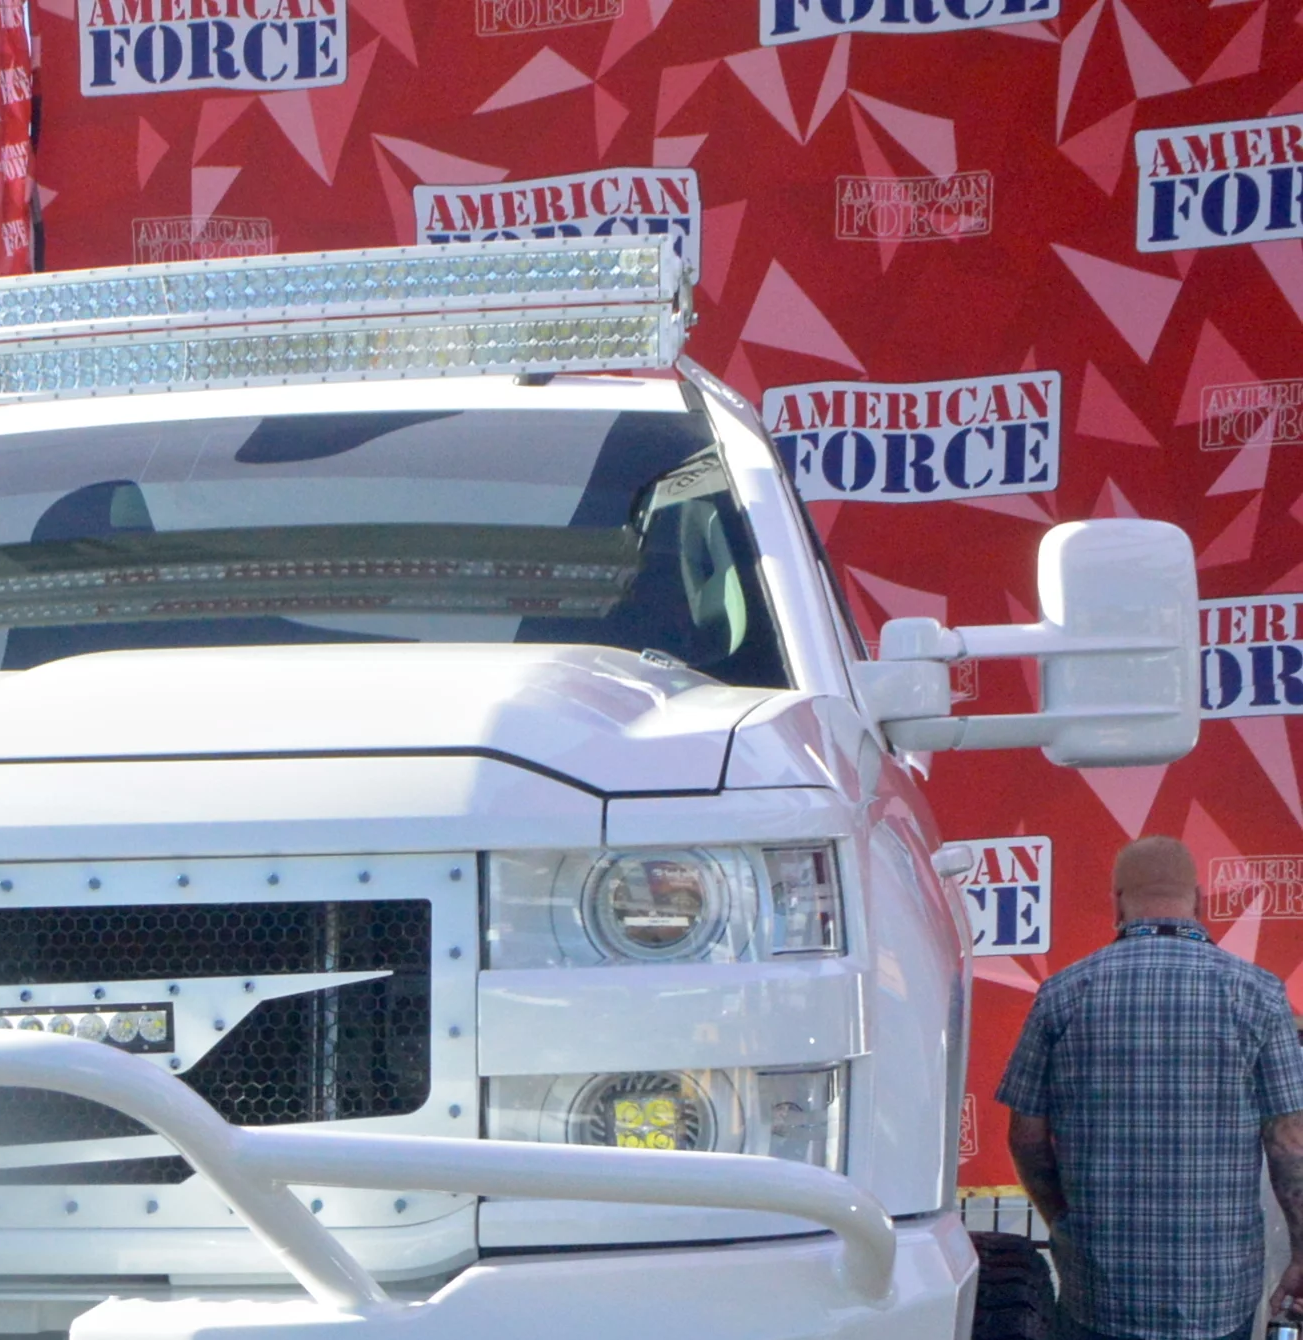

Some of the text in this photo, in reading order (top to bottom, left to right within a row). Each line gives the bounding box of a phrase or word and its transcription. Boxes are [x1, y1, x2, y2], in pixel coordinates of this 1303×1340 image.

[89, 19, 339, 88] FORCE
[424, 177, 690, 231] AMERICAN
[841, 175, 988, 205] AMERICAN
[137, 219, 268, 246] AMERICAN
[841, 200, 988, 237] FORCE
[770, 380, 1053, 433] AMERICAN
[1205, 406, 1303, 446] FOR
[772, 421, 1050, 493] FORCE
[959, 845, 1044, 885] AN
